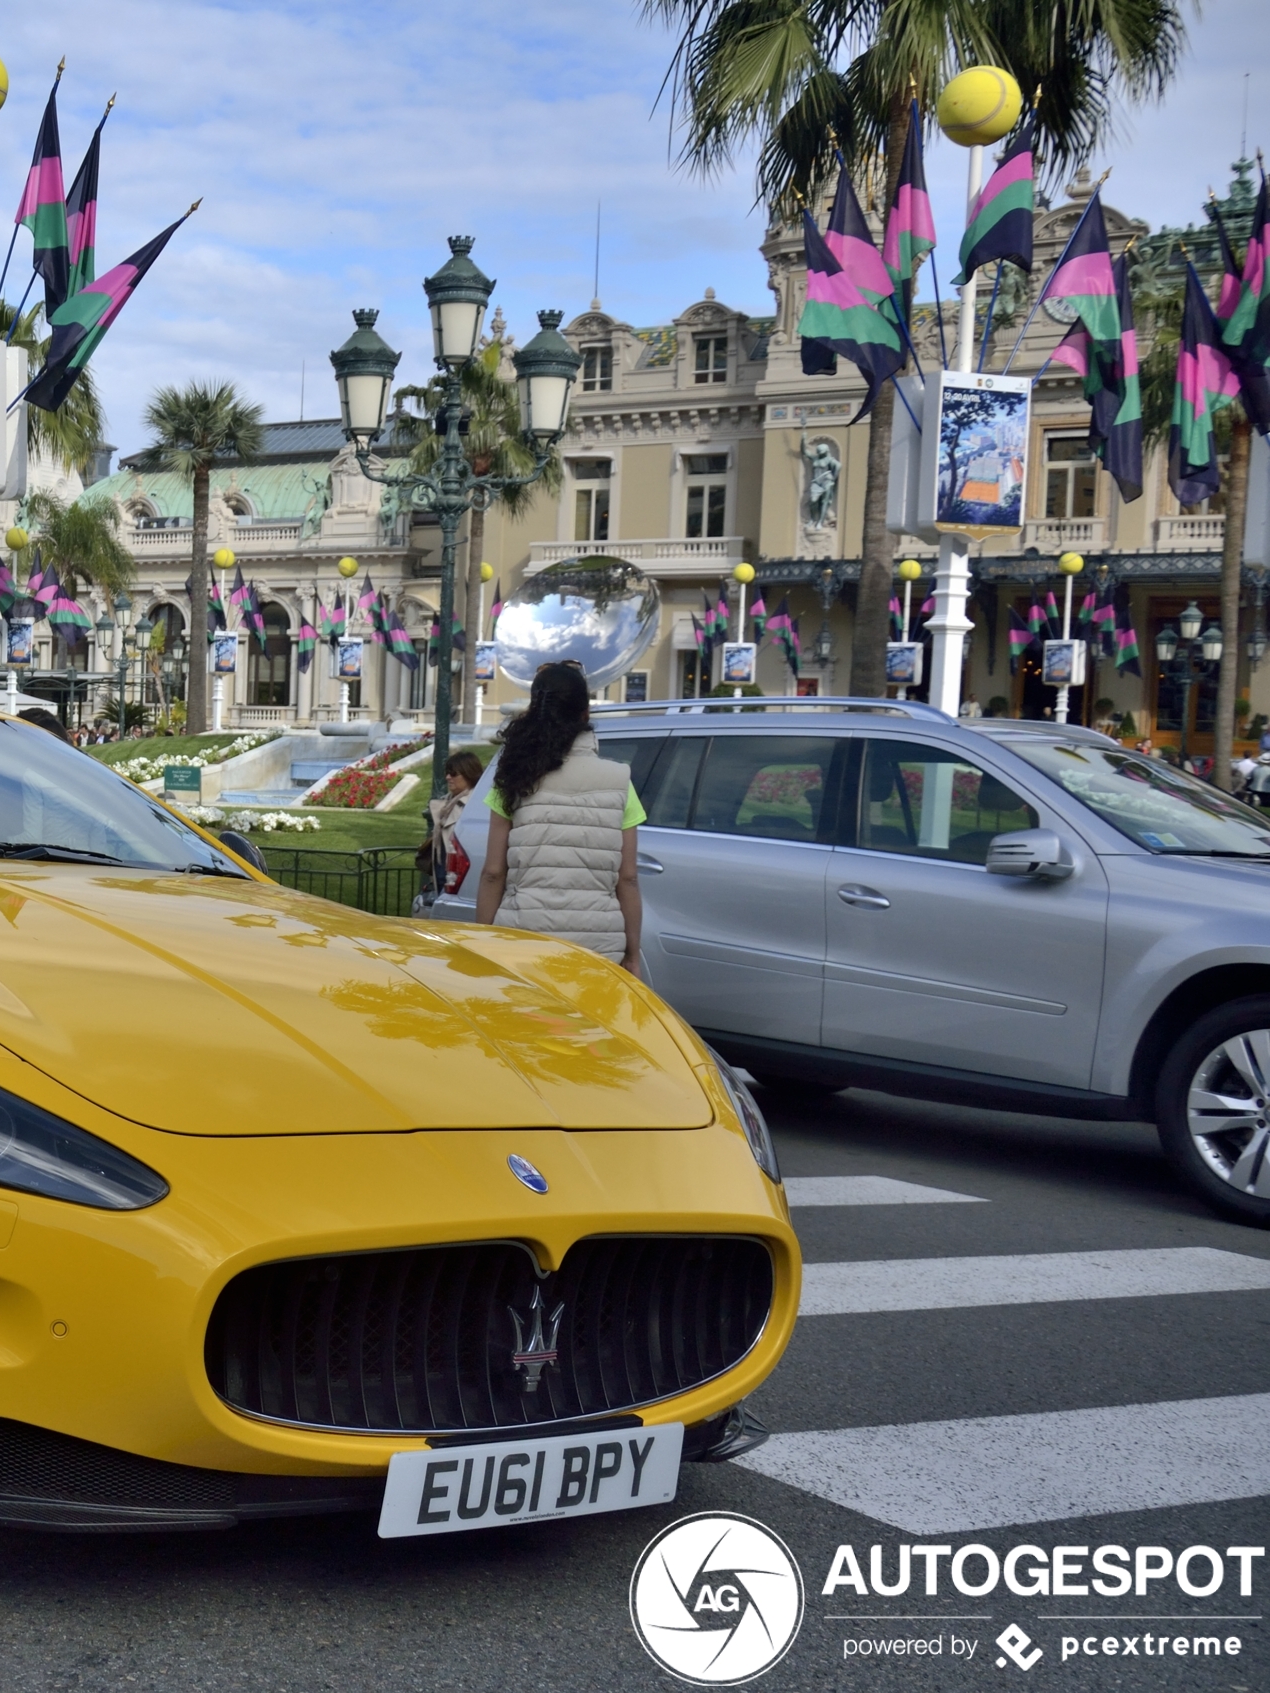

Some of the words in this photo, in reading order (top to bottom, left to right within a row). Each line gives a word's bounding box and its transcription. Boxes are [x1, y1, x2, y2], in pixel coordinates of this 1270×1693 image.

[962, 393, 981, 403] AVRIL
[416, 1451, 546, 1524] EU61
[555, 1436, 655, 1509] BPY
